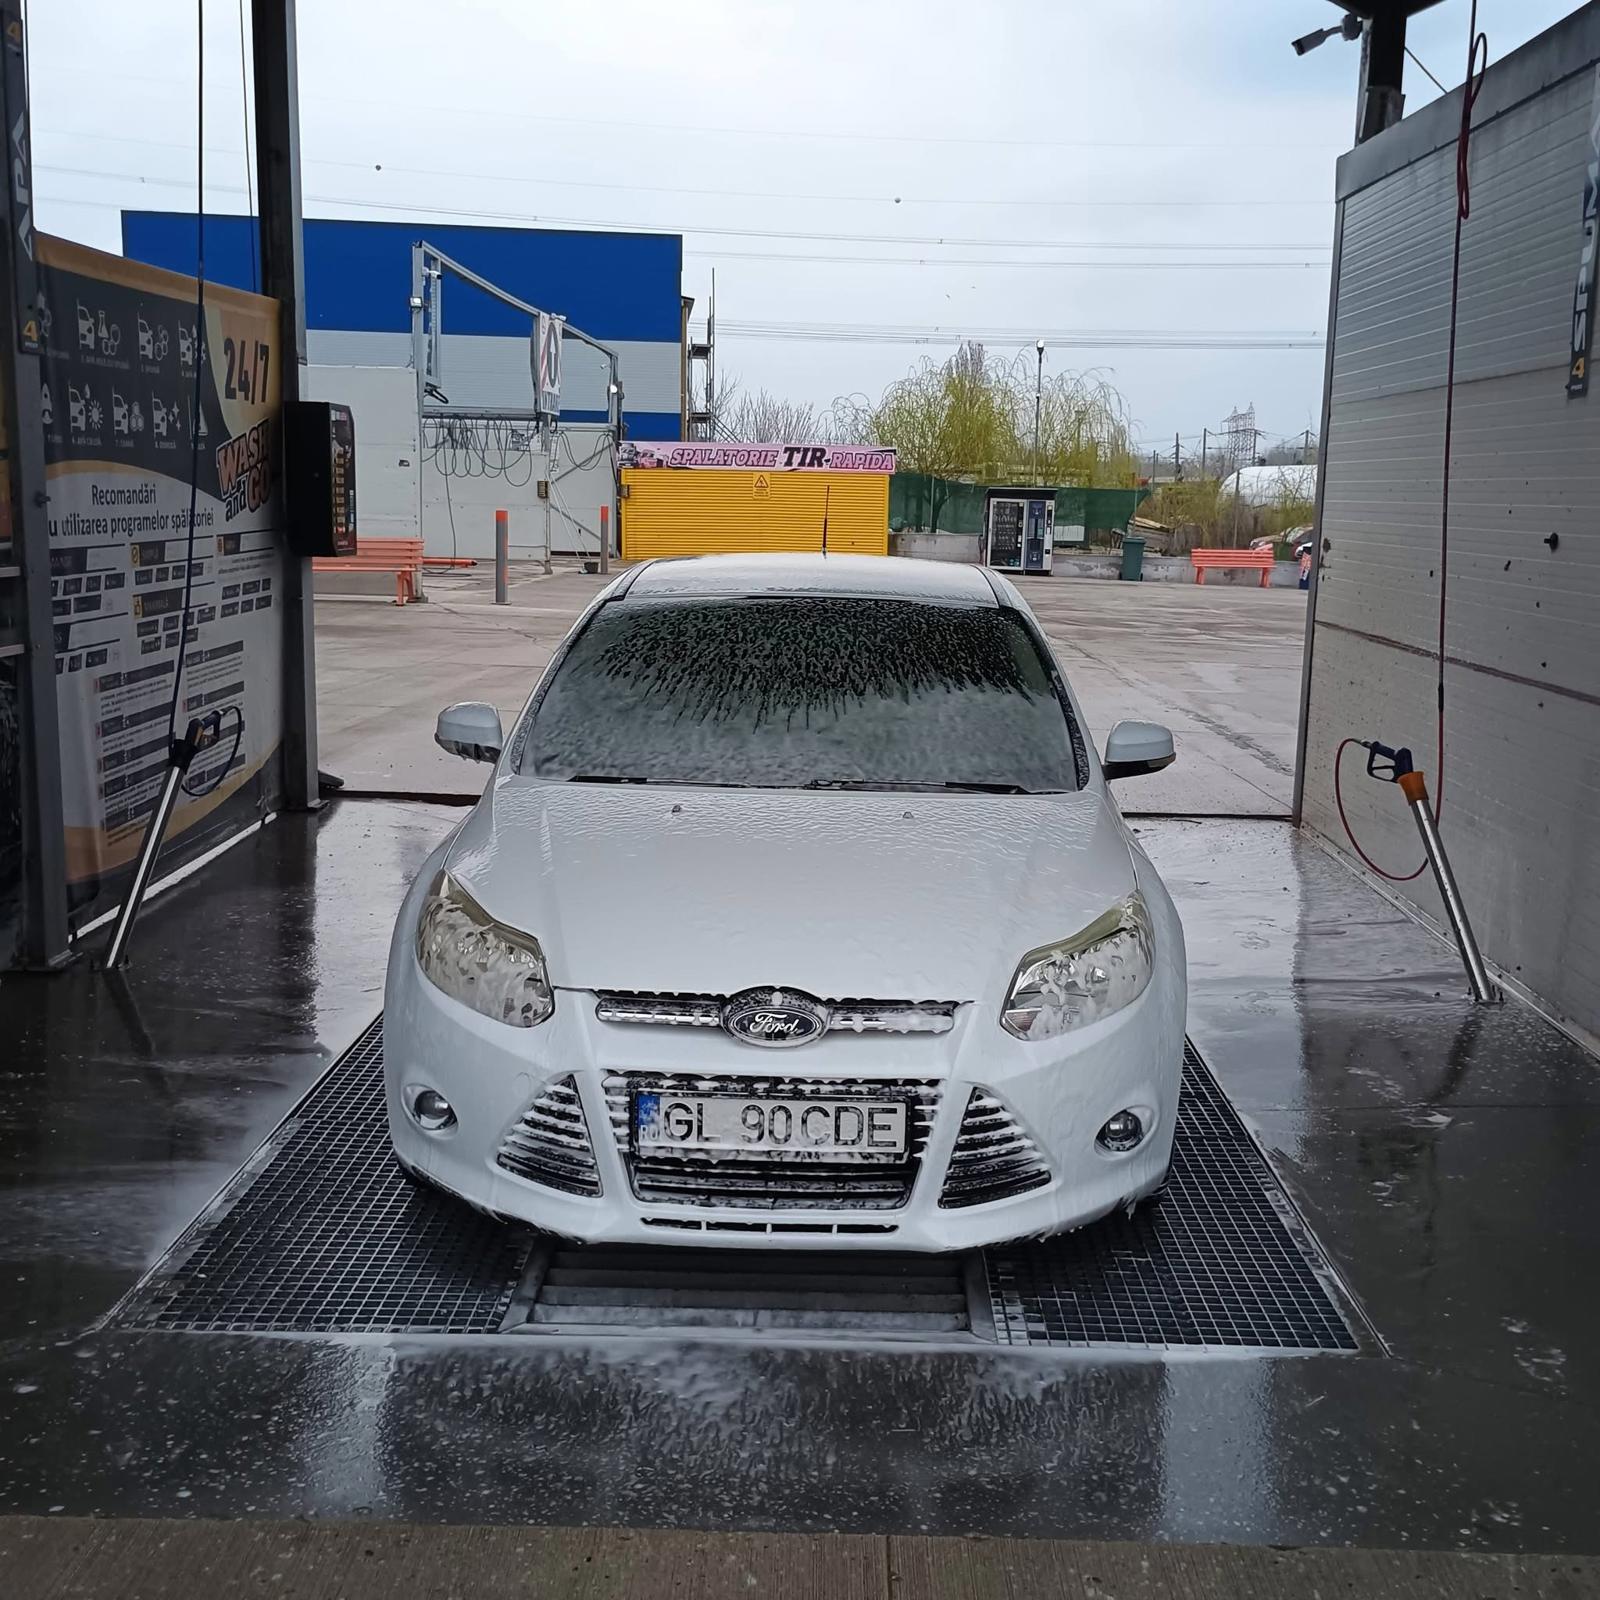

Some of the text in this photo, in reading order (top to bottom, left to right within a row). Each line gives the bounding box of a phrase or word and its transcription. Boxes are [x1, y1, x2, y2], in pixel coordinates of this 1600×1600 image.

[22, 319, 38, 342] 4
[223, 337, 270, 405] 24/7
[1571, 356, 1585, 379] 4
[669, 448, 779, 468] SPALATORIE
[91, 484, 157, 506] Recomandări
[225, 479, 247, 522] and
[62, 512, 108, 537] utilizarea
[111, 509, 169, 539] programelor
[171, 507, 214, 534] spăltoriei
[749, 1012, 801, 1035] Ford
[663, 1102, 721, 1143] GL
